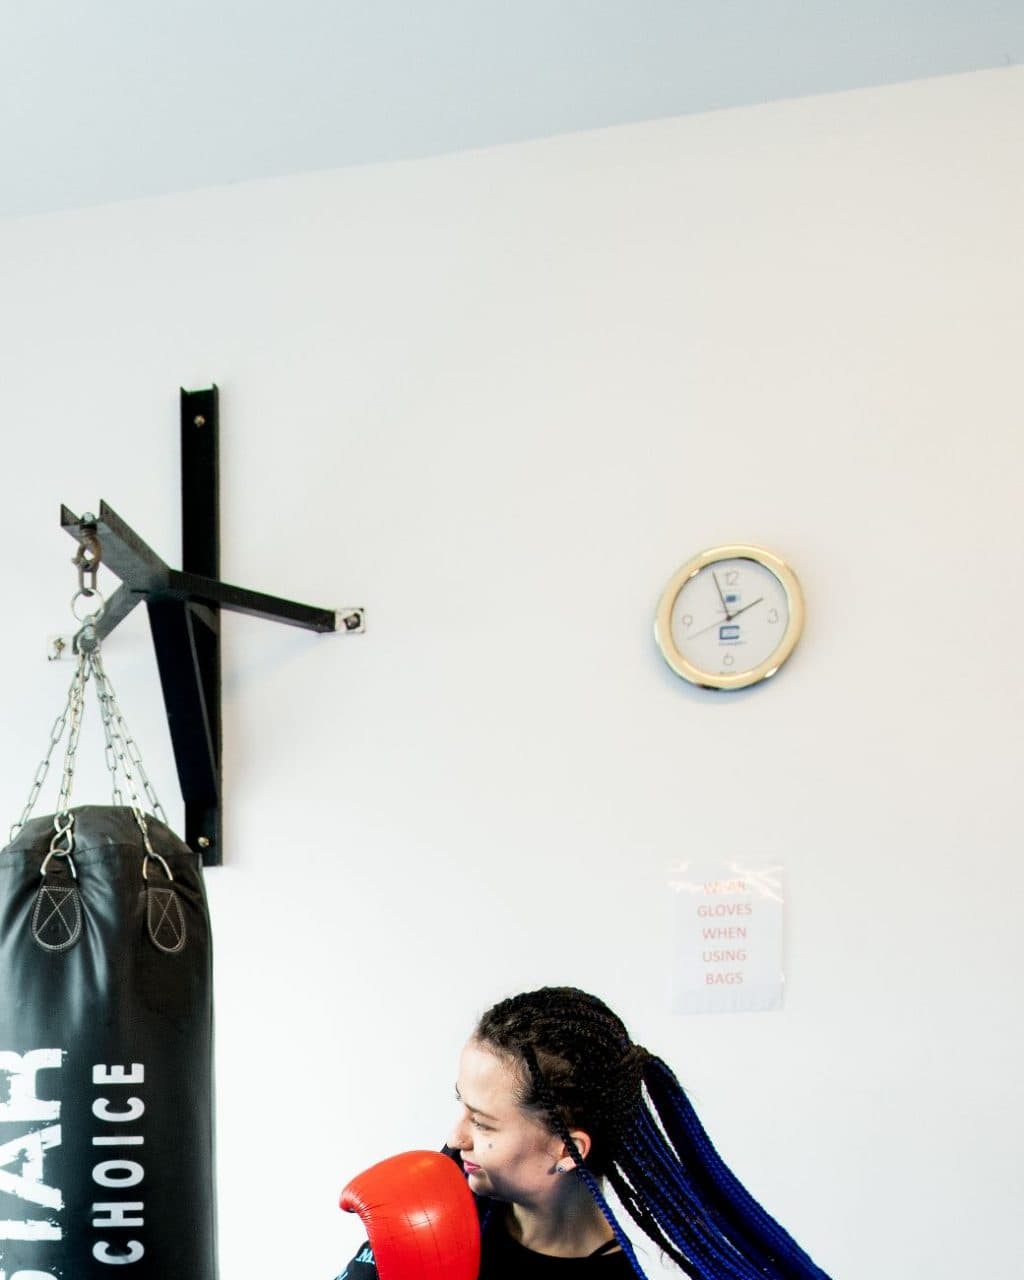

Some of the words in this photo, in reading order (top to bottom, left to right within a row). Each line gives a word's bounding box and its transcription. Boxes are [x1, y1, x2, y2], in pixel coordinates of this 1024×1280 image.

[696, 903, 753, 918] GLOVES
[702, 927, 747, 940] WHEN
[702, 950, 747, 963] USING
[705, 972, 744, 985] BAGS
[92, 1063, 145, 1265] CHOICE
